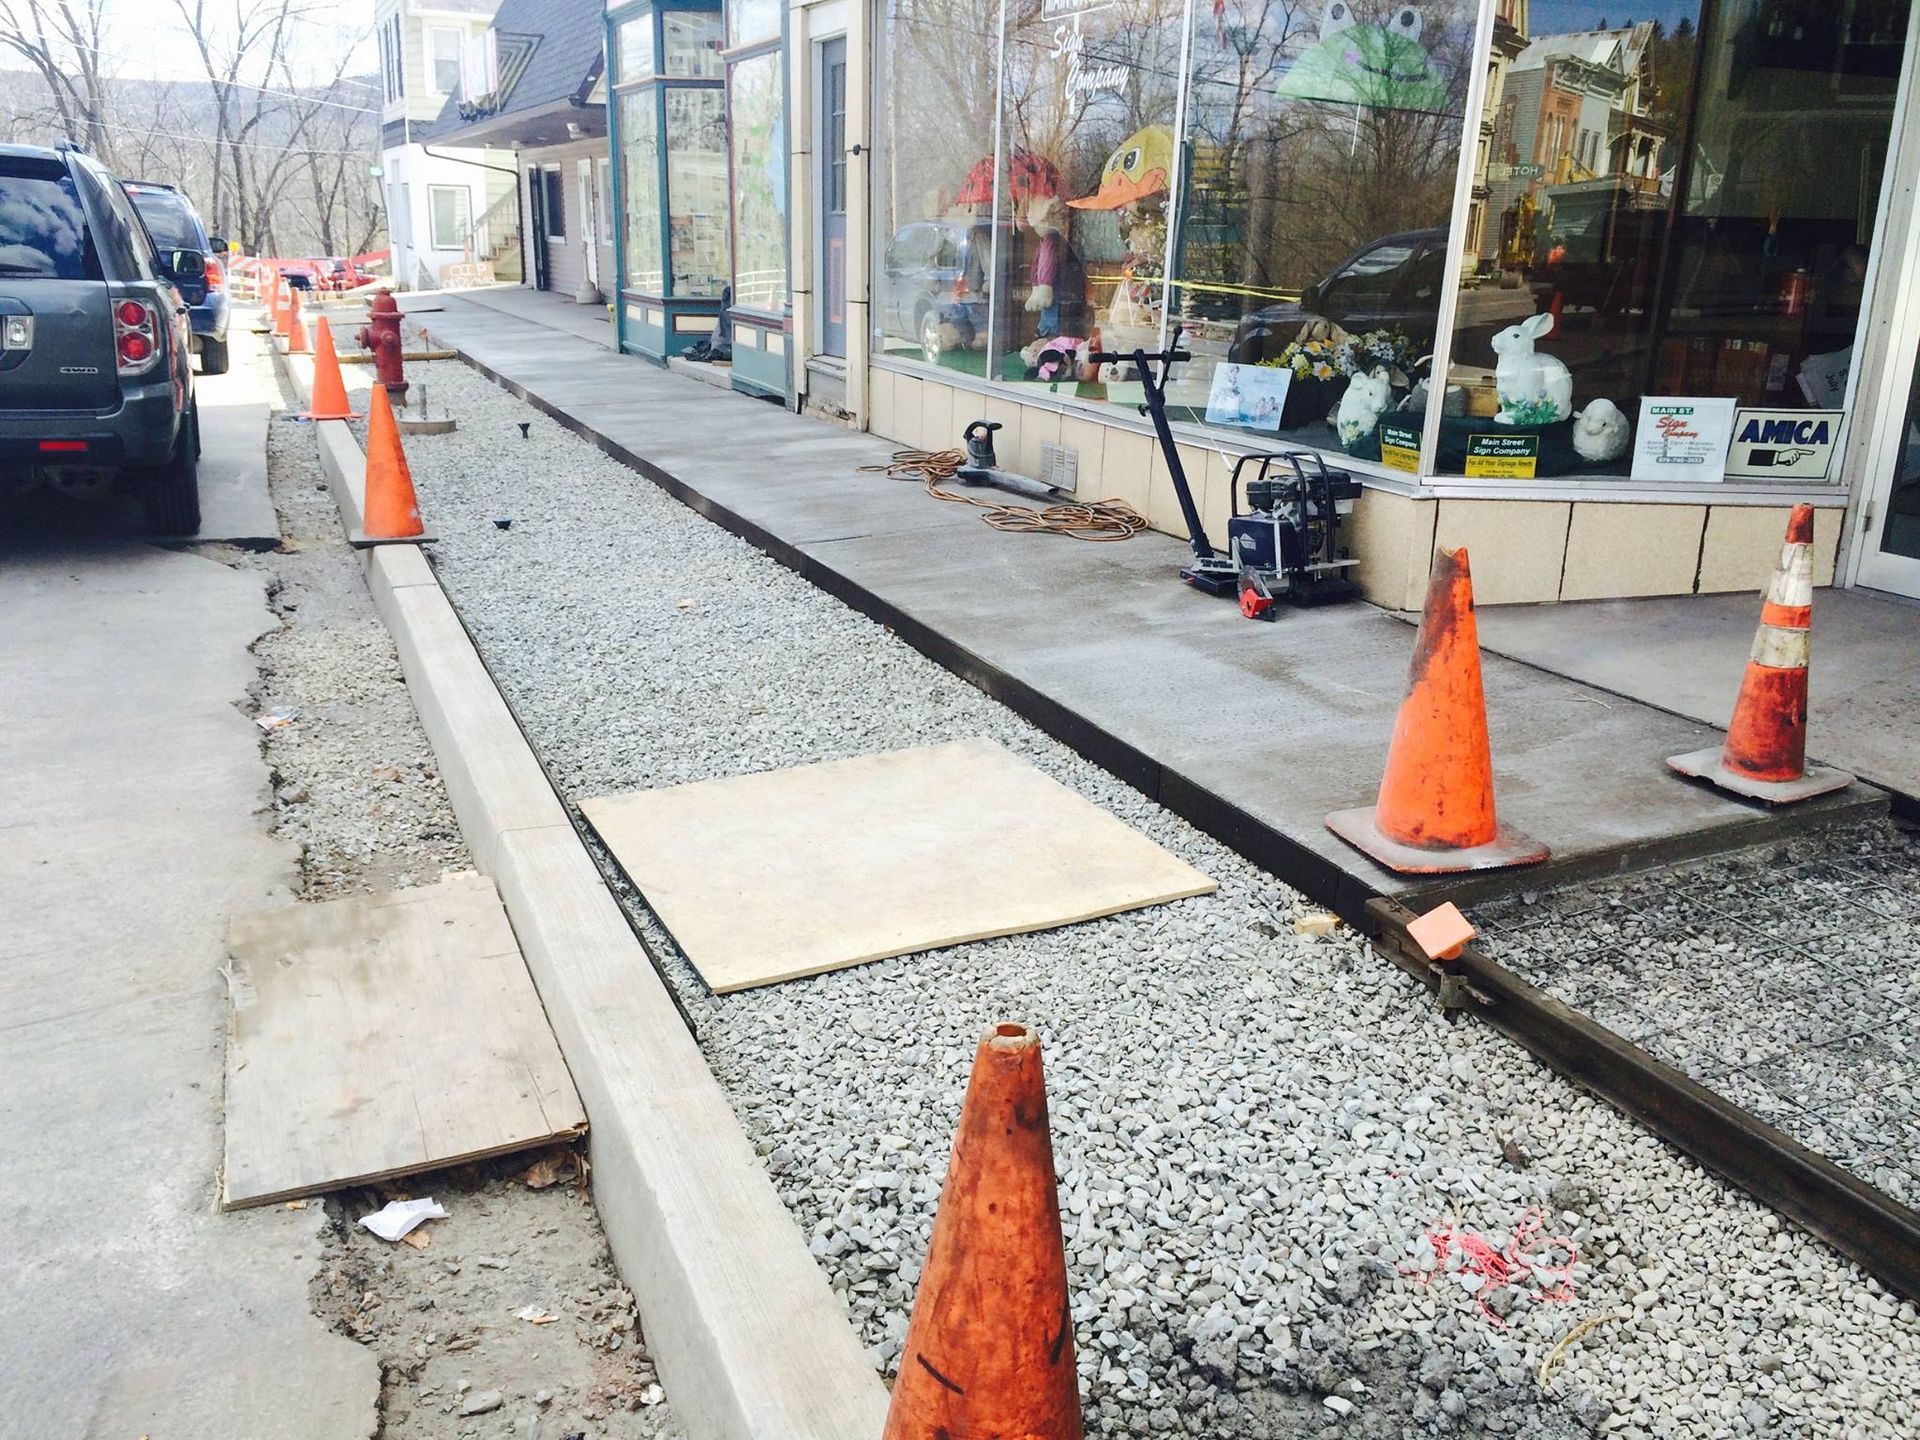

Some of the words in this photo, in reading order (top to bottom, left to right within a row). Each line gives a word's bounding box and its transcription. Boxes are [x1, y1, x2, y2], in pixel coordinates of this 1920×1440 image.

[1050, 25, 1084, 64] Sign
[1064, 59, 1130, 99] Company
[1655, 415, 1688, 431] Sign
[1661, 428, 1698, 439] Company
[1737, 419, 1829, 445] AMICA
[1481, 438, 1500, 446] Main
[1501, 438, 1525, 446] Street
[1473, 446, 1491, 455] Sign
[1493, 447, 1531, 456] Company
